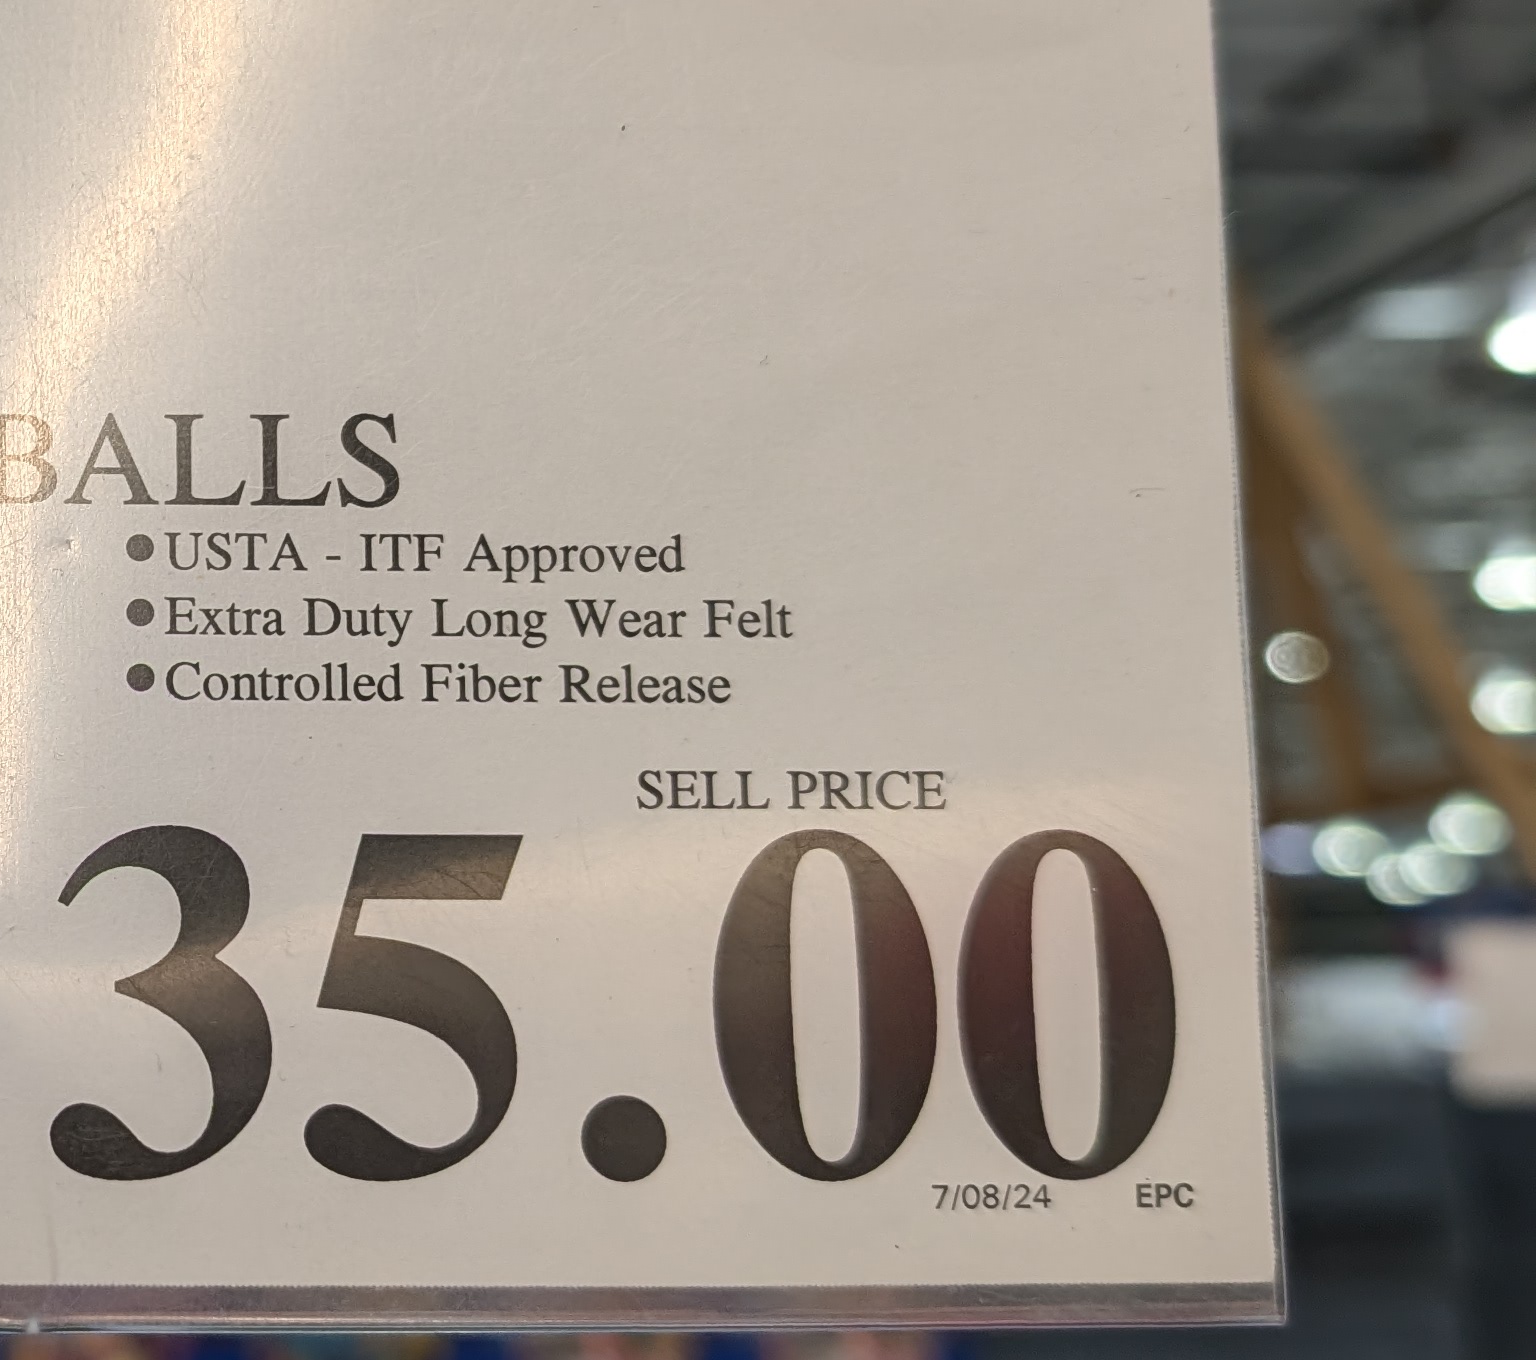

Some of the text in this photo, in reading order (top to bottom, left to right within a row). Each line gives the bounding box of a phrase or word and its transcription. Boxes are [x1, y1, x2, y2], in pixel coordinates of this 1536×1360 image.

[164, 532, 308, 571] USTA
[359, 534, 444, 571] ITF
[463, 533, 686, 583] Approved
[164, 596, 793, 649] Extra Duty Long Wear Felt
[166, 662, 732, 704] Controlled Fiber Release
[637, 770, 946, 810] SELL PRICE
[50, 825, 1176, 1182] 35.00
[932, 1184, 1052, 1210] 7/08/24
[1136, 1183, 1194, 1208] EPC
